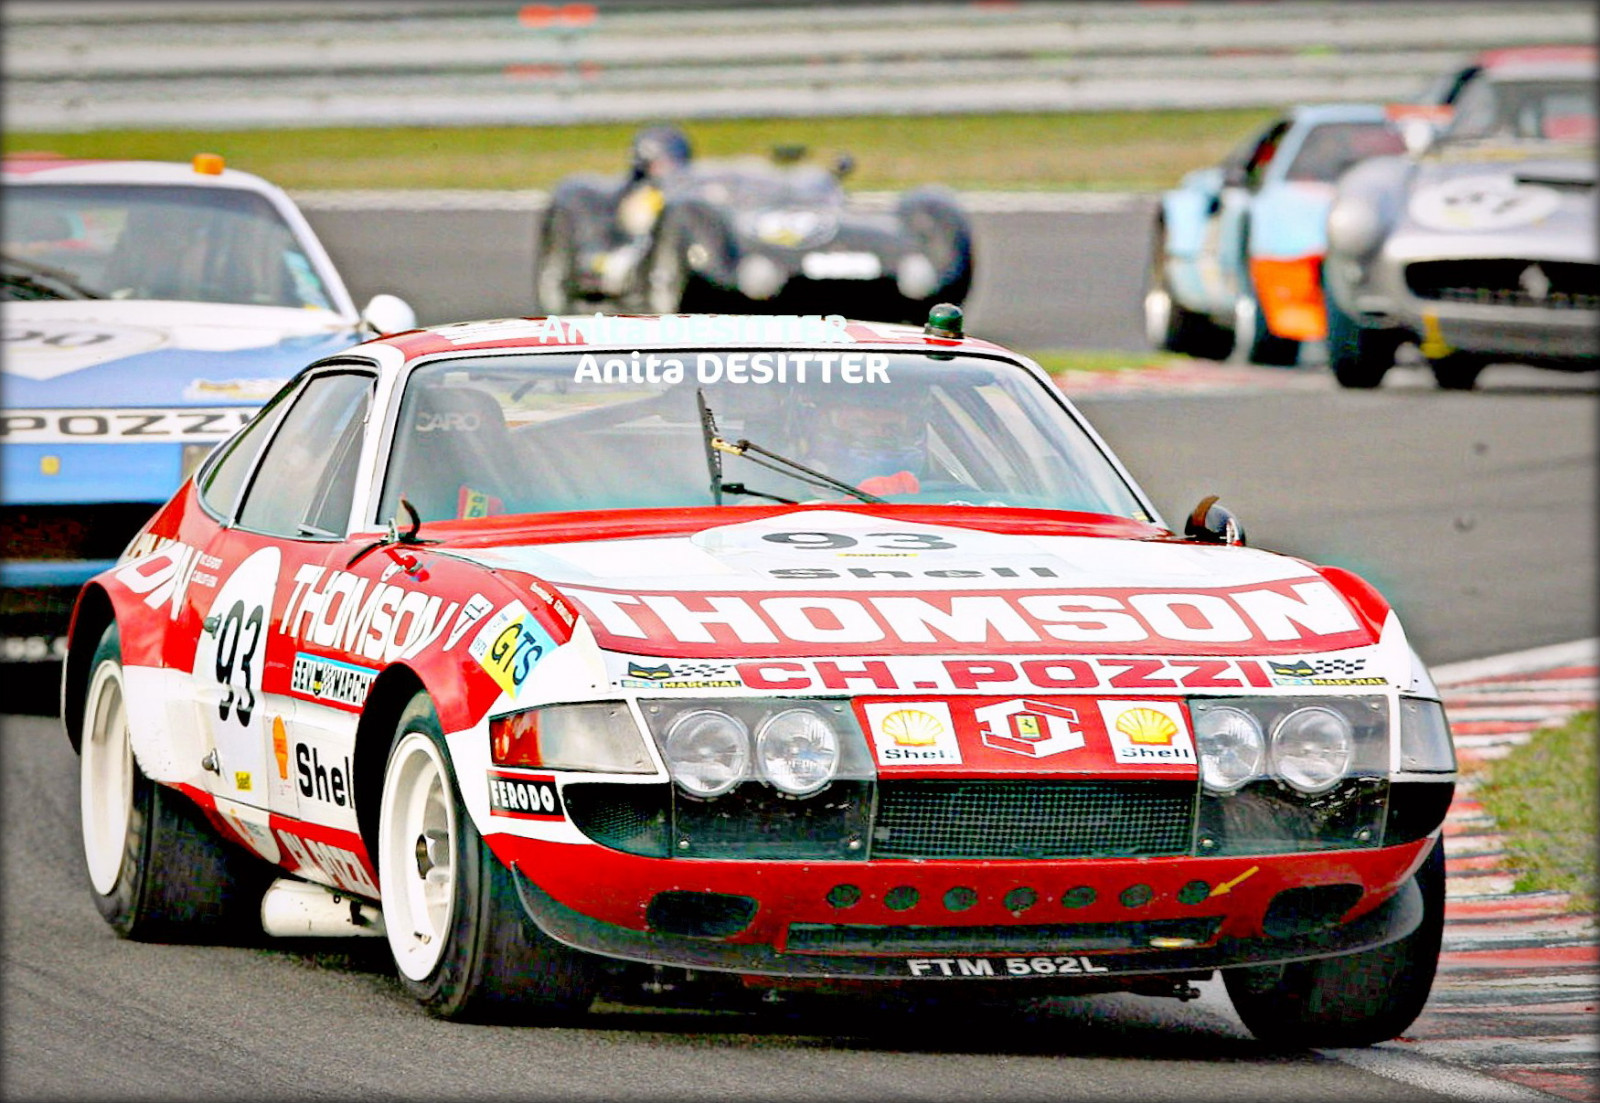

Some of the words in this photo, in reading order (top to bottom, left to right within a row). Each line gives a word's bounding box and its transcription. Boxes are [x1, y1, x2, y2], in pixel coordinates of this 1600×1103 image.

[761, 532, 957, 550] 93
[768, 567, 1058, 578] Shell
[280, 563, 460, 662] THOMSON
[560, 582, 1361, 644] THOMSON
[216, 599, 264, 727] 93
[490, 622, 543, 686] GTS
[663, 680, 741, 689] MARCHAL
[1311, 677, 1387, 686] MARCHAL
[1121, 747, 1190, 758] Shell
[490, 779, 555, 813] FERODO
[908, 957, 994, 977] FTM
[1006, 956, 1109, 975] 562L
